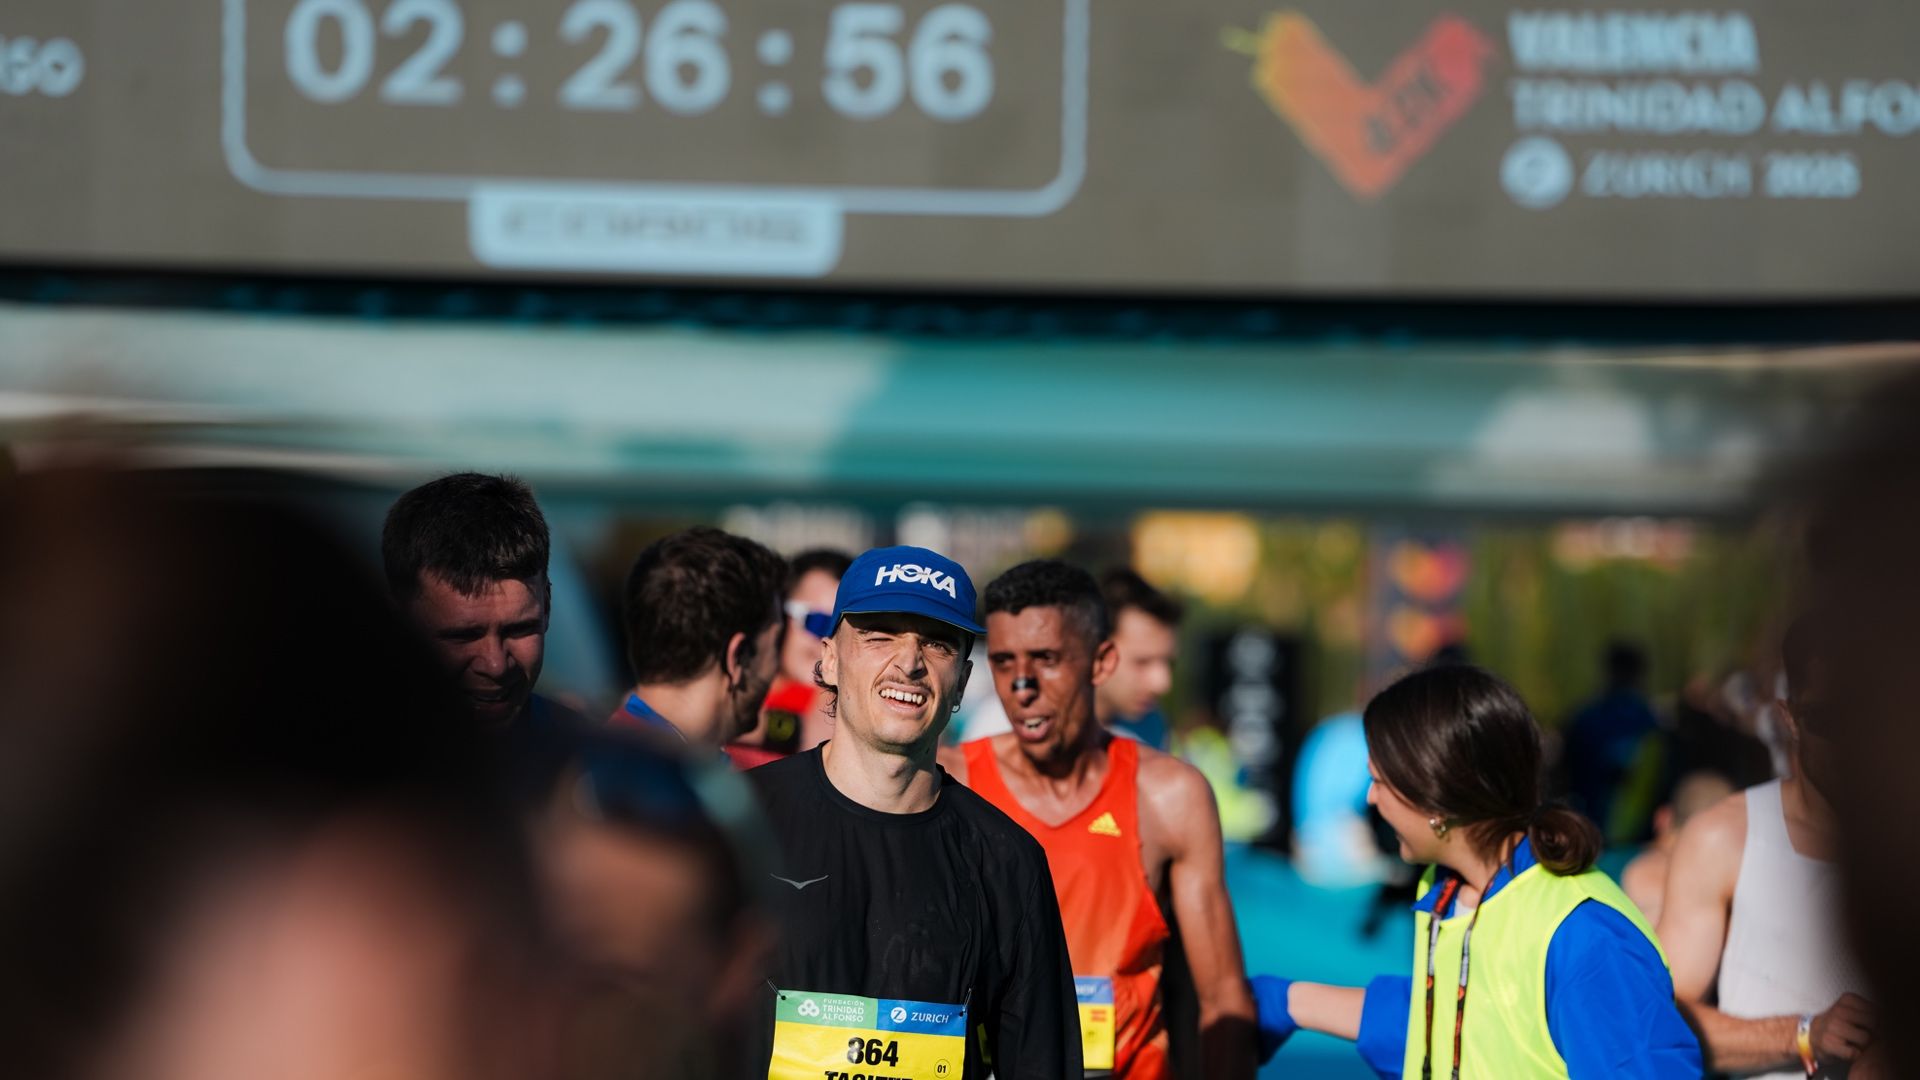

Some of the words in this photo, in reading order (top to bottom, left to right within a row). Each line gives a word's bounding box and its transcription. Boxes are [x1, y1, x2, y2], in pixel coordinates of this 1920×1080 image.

[1508, 13, 1758, 72] VALENCIA
[0, 36, 84, 97] SO
[1511, 80, 1766, 134] TRINIDAD
[874, 563, 957, 599] HOKA
[822, 1013, 864, 1023] ALFONSO
[823, 1005, 864, 1015] TRINIDAD
[911, 1012, 949, 1024] ZURICH
[847, 1036, 899, 1067] 864
[937, 1064, 947, 1074] 01
